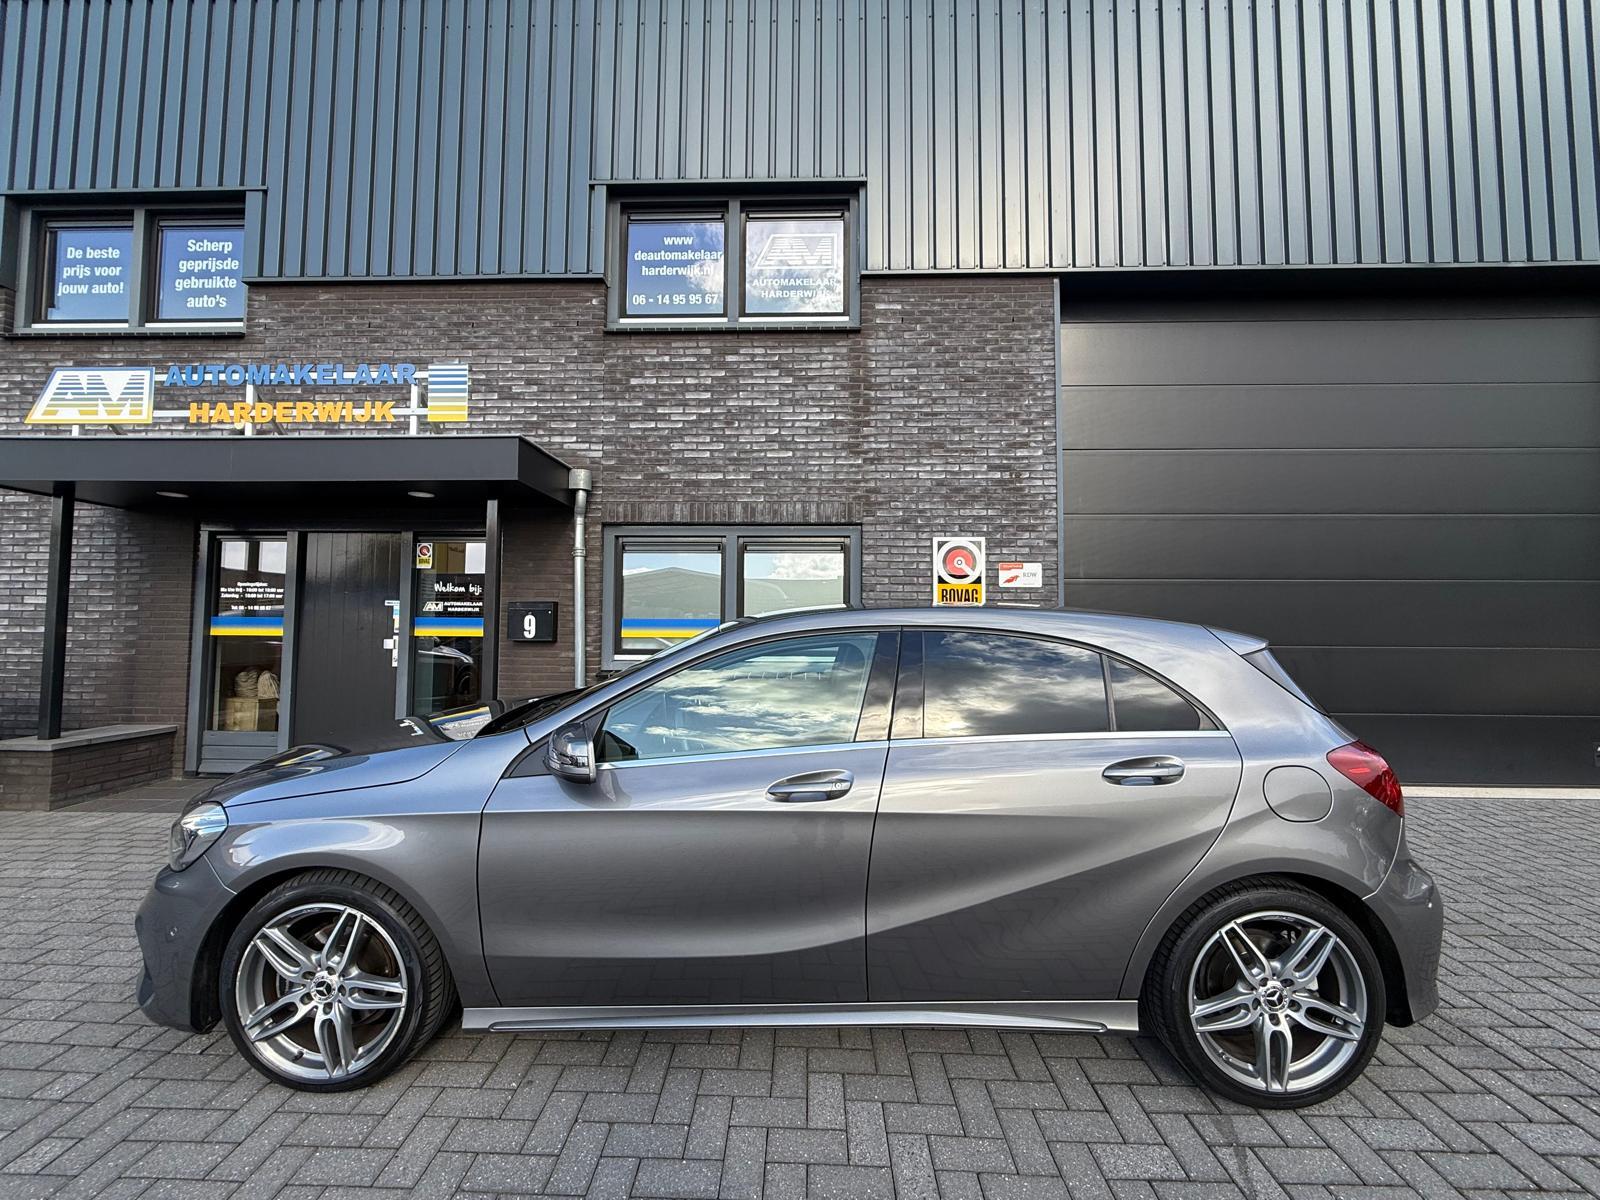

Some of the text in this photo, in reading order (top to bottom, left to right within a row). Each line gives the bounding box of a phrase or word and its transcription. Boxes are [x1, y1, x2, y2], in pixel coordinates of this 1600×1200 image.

[187, 239, 233, 253] Scherp
[663, 236, 693, 245] www
[66, 247, 120, 259] De beste
[634, 250, 722, 260] deautomakelaar
[63, 265, 122, 277] prijs voor
[178, 258, 239, 272] geprijsde
[641, 265, 714, 277] harderwijk.nl
[175, 277, 237, 291] gebruikte
[752, 278, 837, 287] AUTOMAKELAAR
[57, 283, 124, 296] jouw auto!
[761, 290, 833, 298] HARDERWI
[632, 295, 646, 305] 06
[656, 295, 669, 305] 14
[672, 295, 686, 305] 95
[688, 295, 702, 305] 95
[705, 294, 719, 305] 67
[164, 363, 418, 387] AUTOMAKELAAR
[189, 401, 396, 424] HARDERWIJK
[434, 581, 483, 596] Welkom bij:
[523, 614, 536, 639] 9
